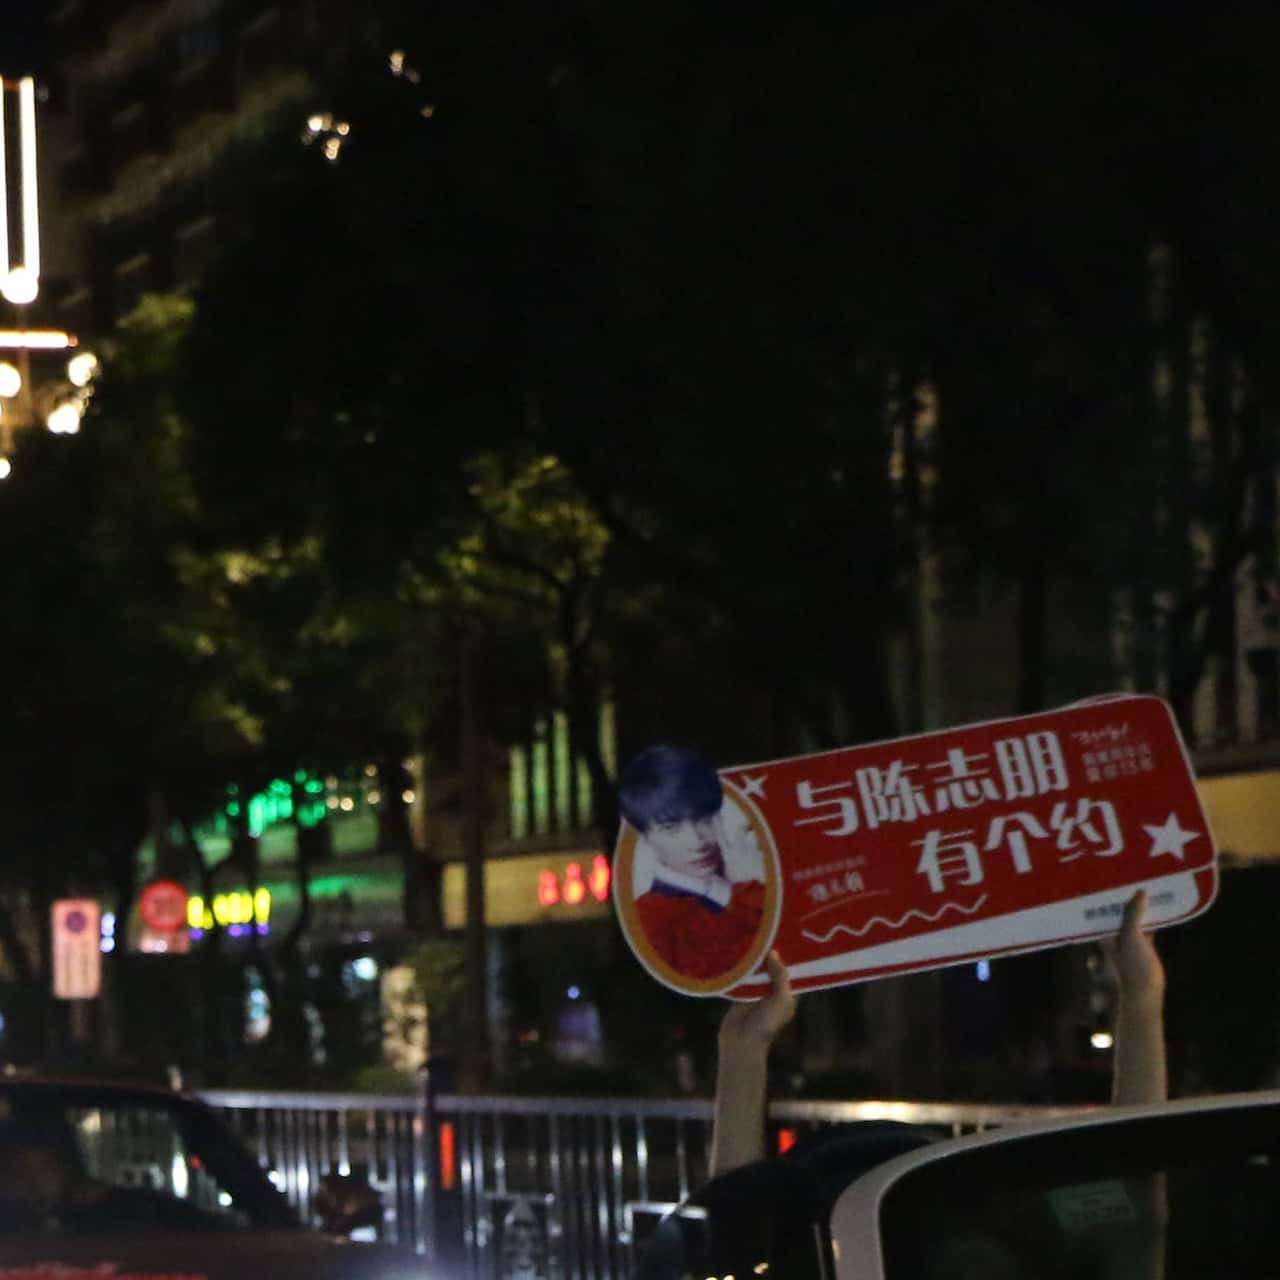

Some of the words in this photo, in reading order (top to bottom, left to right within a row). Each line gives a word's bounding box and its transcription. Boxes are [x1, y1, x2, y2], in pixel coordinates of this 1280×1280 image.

[792, 730, 1071, 836] 与陈志朋
[911, 796, 1126, 893] 有个约
